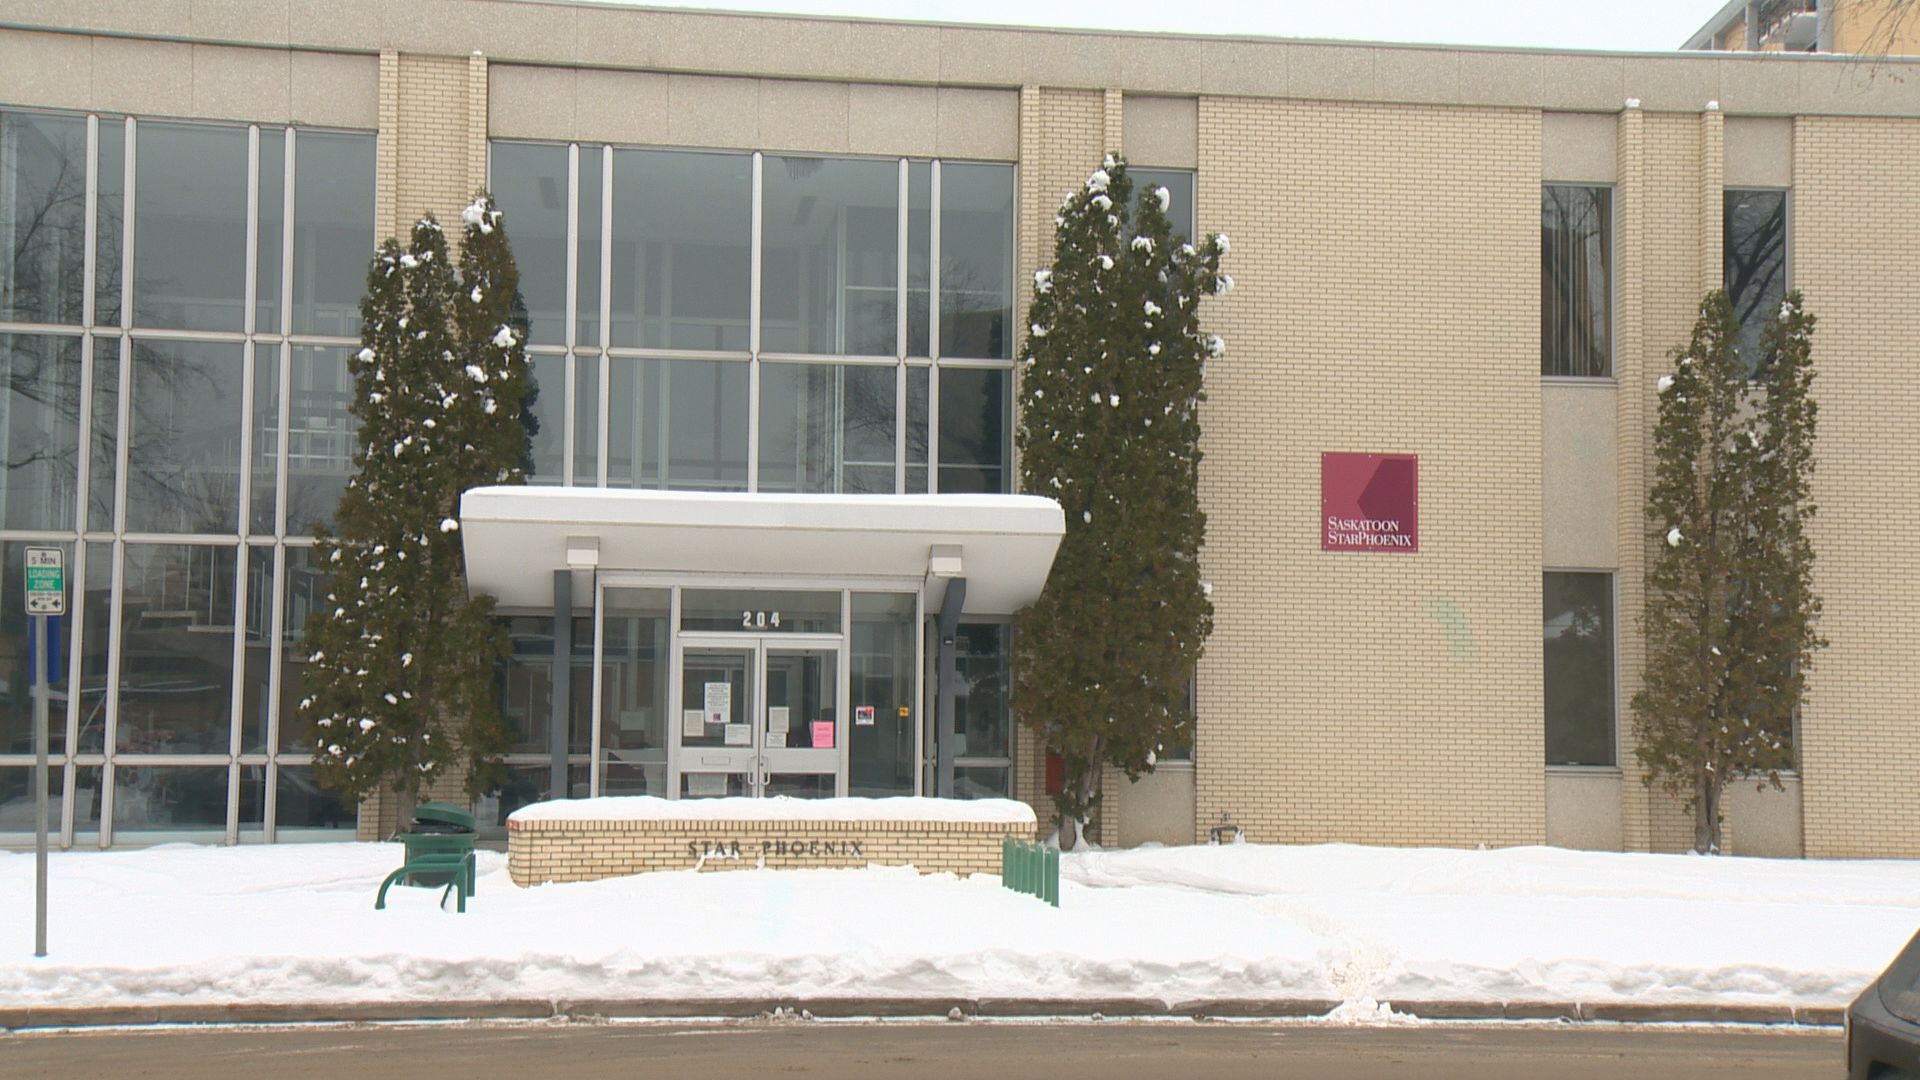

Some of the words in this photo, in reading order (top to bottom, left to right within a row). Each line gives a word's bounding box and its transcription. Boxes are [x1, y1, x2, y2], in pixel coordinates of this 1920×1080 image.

[1328, 516, 1399, 532] SASKATOON
[40, 557, 56, 565] MIN
[29, 569, 61, 578] LOADING
[34, 580, 56, 589] ZONE
[743, 611, 780, 627] 204
